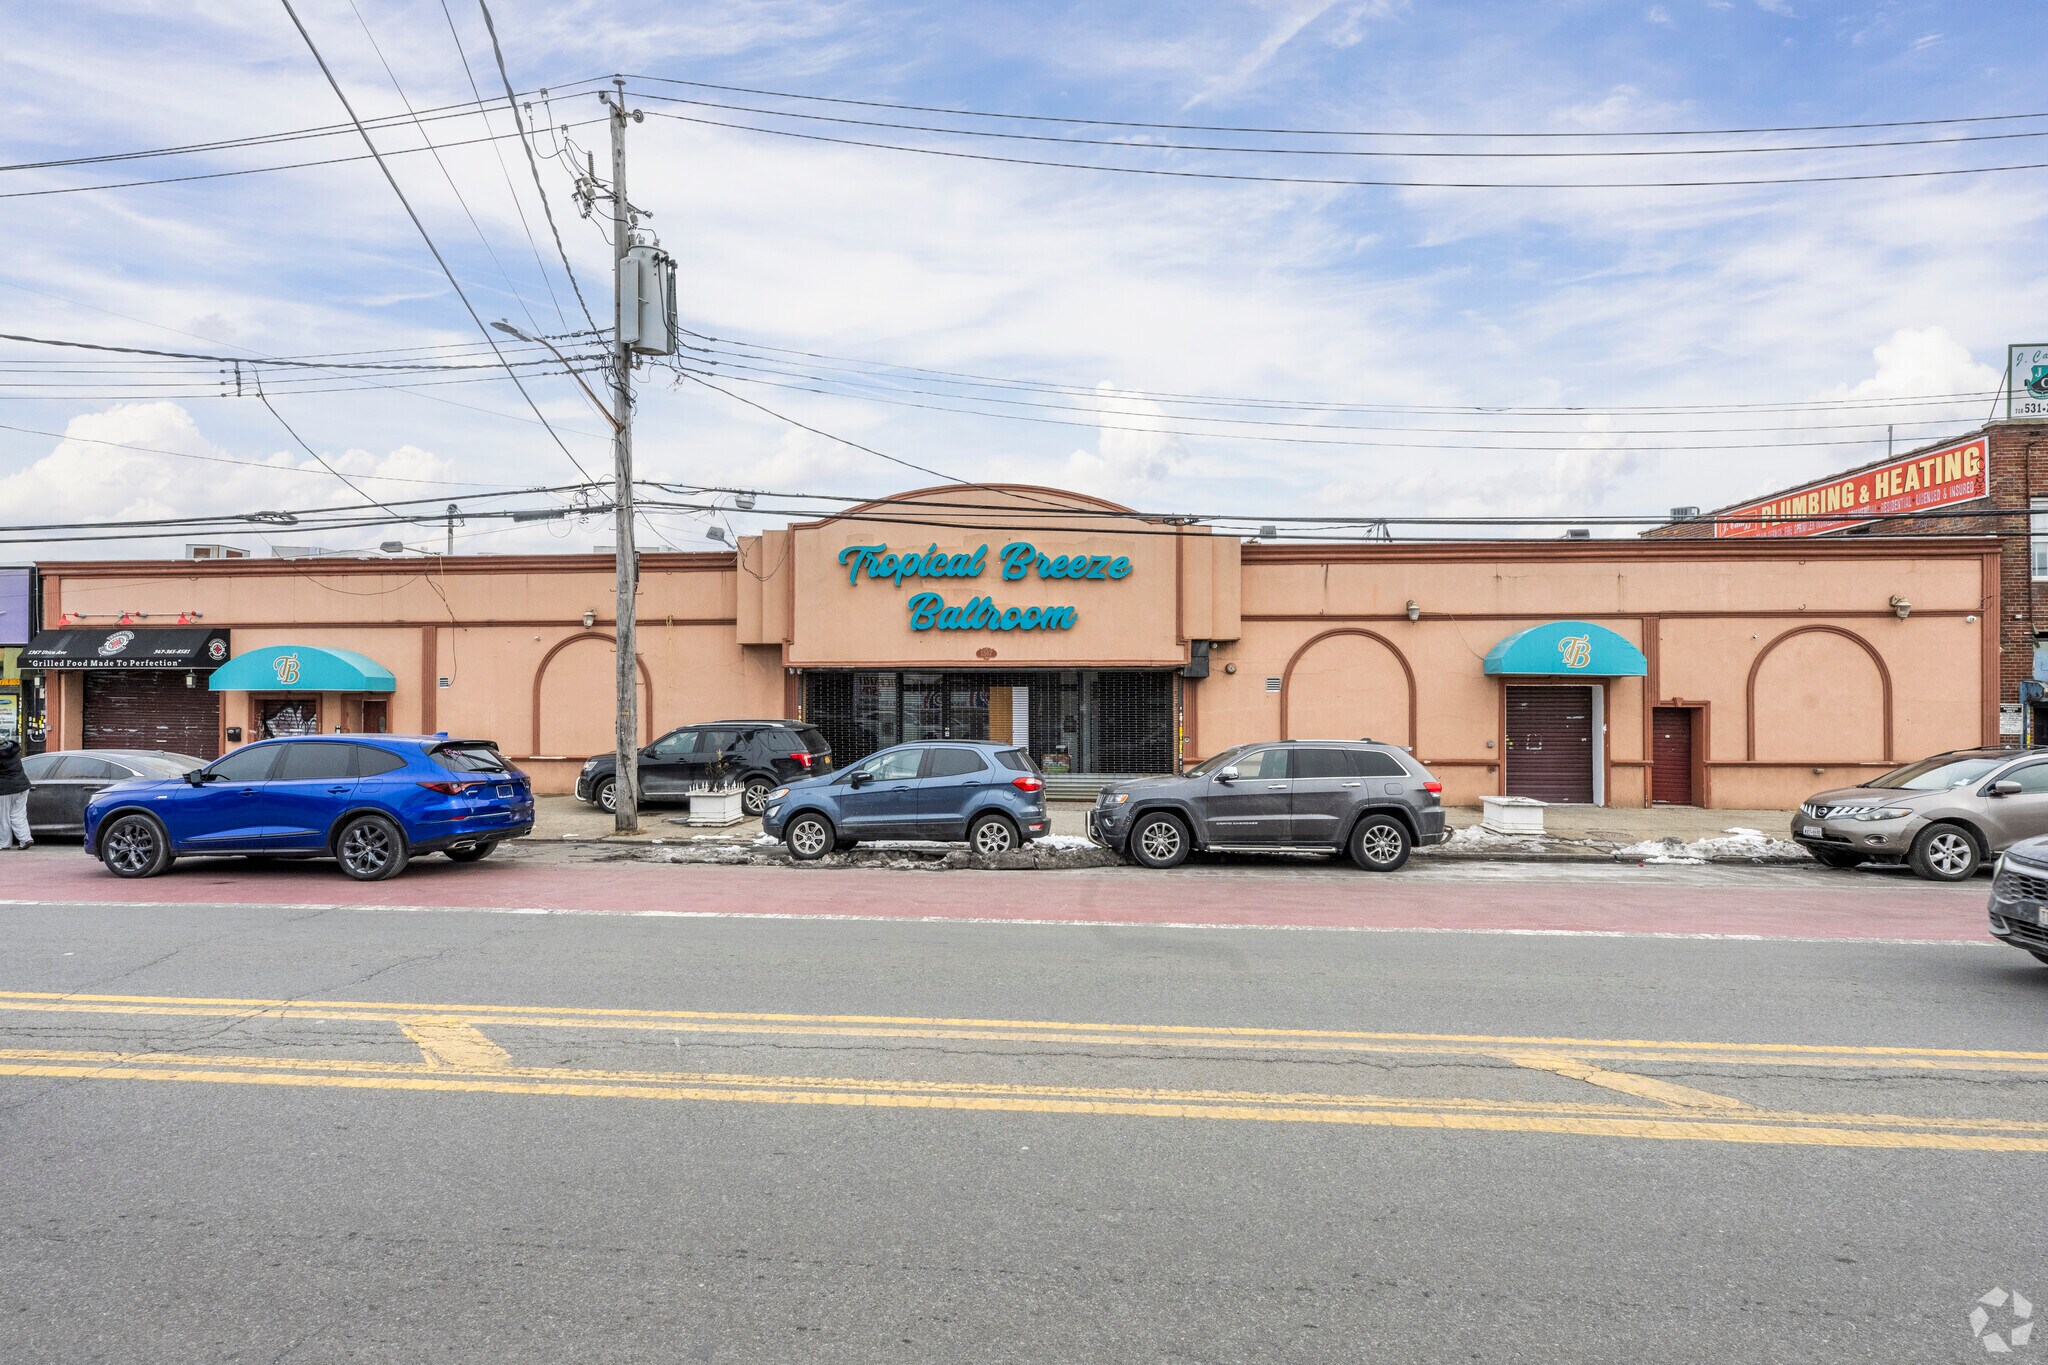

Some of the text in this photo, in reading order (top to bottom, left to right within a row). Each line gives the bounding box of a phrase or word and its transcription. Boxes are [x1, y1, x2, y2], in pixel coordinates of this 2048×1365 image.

[1761, 446, 1980, 529] PLUMBING & HEATING
[1950, 481, 1974, 498] INSURED
[838, 542, 1133, 587] Tropical Breeze
[907, 592, 1078, 631] Ballroom
[66, 659, 88, 667] Food
[90, 659, 114, 667] Made
[116, 659, 128, 667] To
